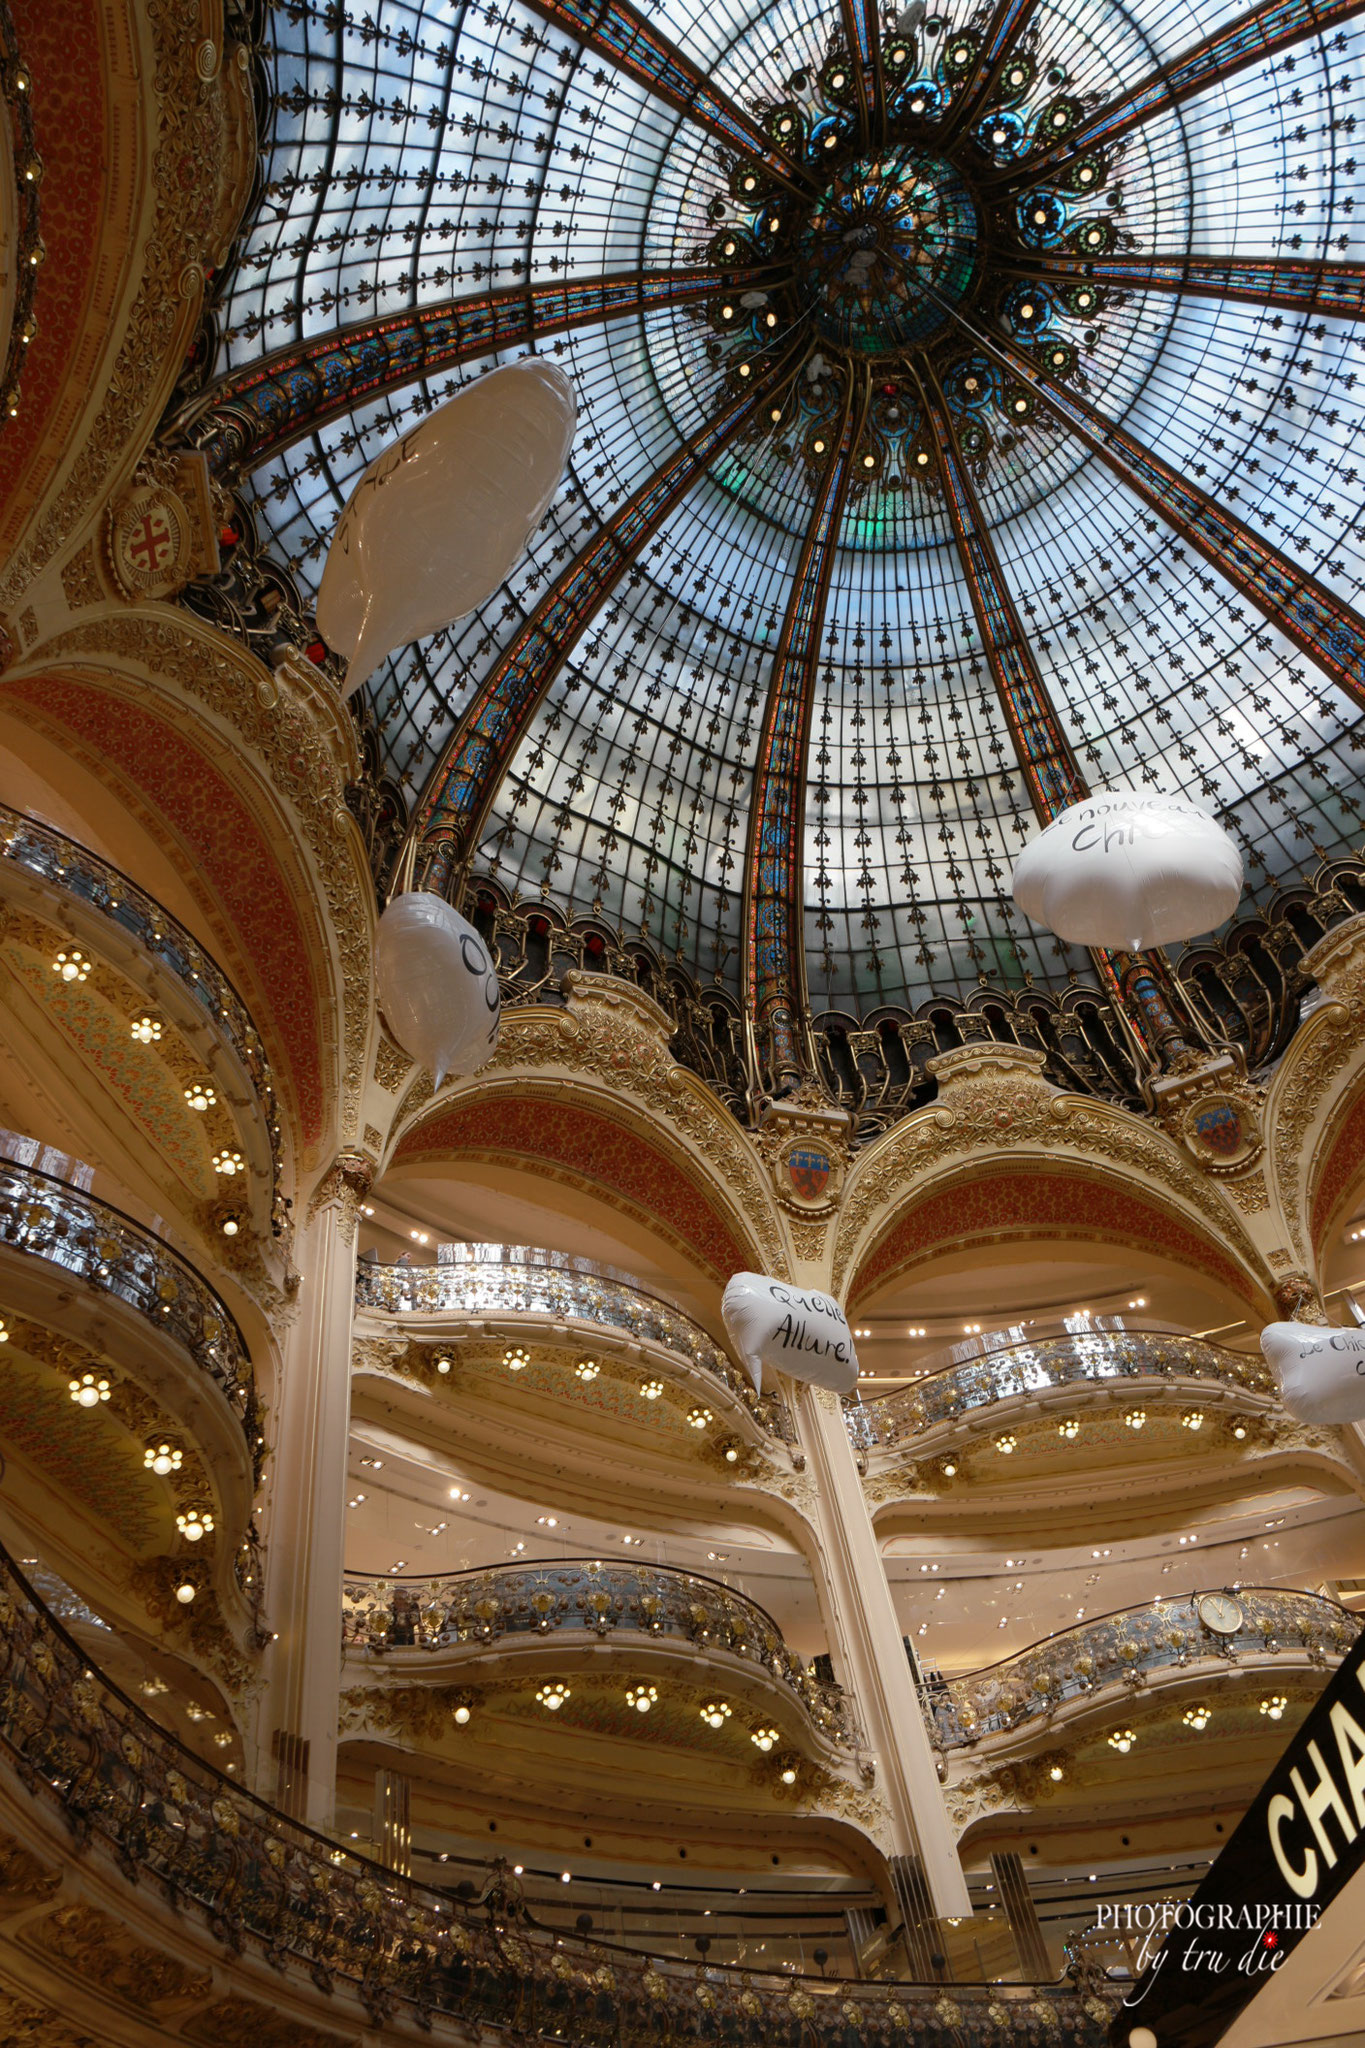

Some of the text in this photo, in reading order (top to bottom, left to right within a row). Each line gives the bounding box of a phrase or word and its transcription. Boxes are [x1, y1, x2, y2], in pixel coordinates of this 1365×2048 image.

[769, 1286, 846, 1326] Quelle
[772, 1314, 852, 1364] Allure!
[1299, 1343, 1323, 1359] Le
[1267, 1659, 1365, 1899] CHA
